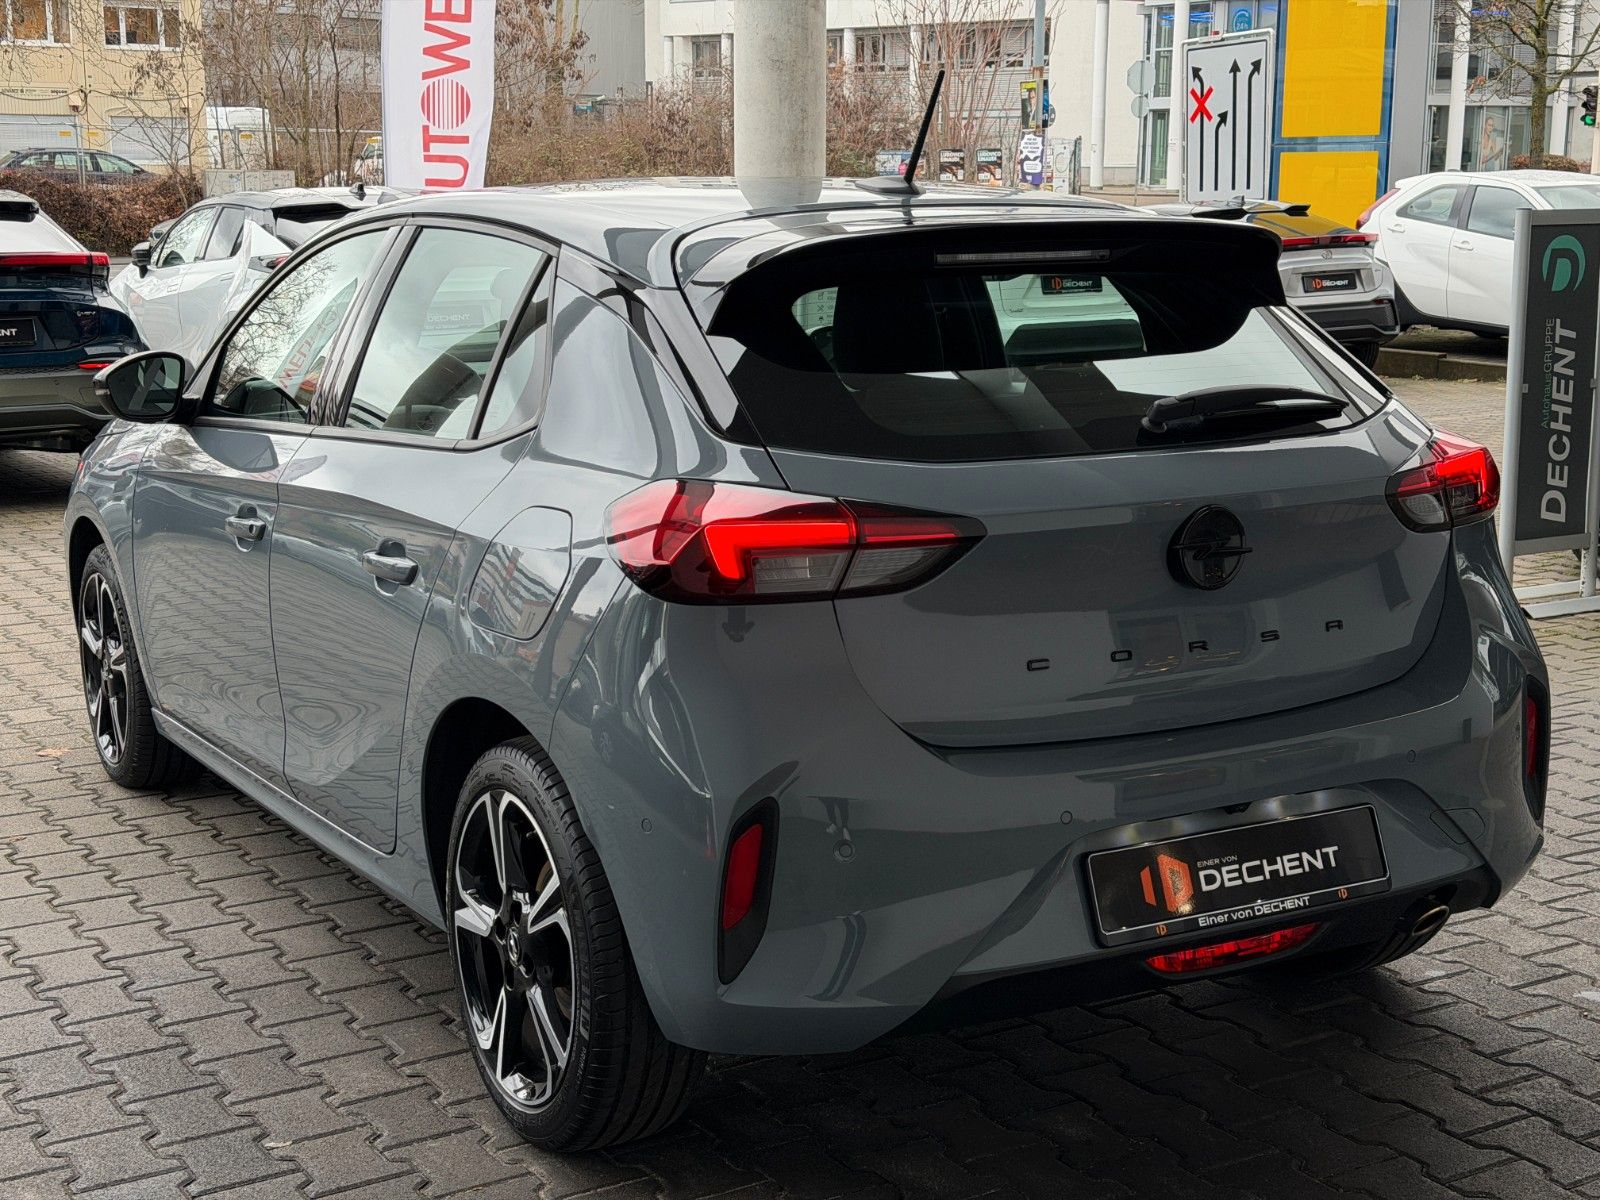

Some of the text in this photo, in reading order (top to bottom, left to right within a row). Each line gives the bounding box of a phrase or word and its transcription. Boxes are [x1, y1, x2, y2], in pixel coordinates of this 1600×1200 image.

[421, 0, 472, 190] UTOWE
[1542, 318, 1555, 430] AutohausGRUPPE
[1540, 319, 1577, 523] DECHENT
[1026, 619, 1344, 672] CORSA
[1197, 855, 1238, 868] EINER VON
[1198, 845, 1339, 892] DECHENT
[1198, 896, 1310, 928] Einer von DECHENT
